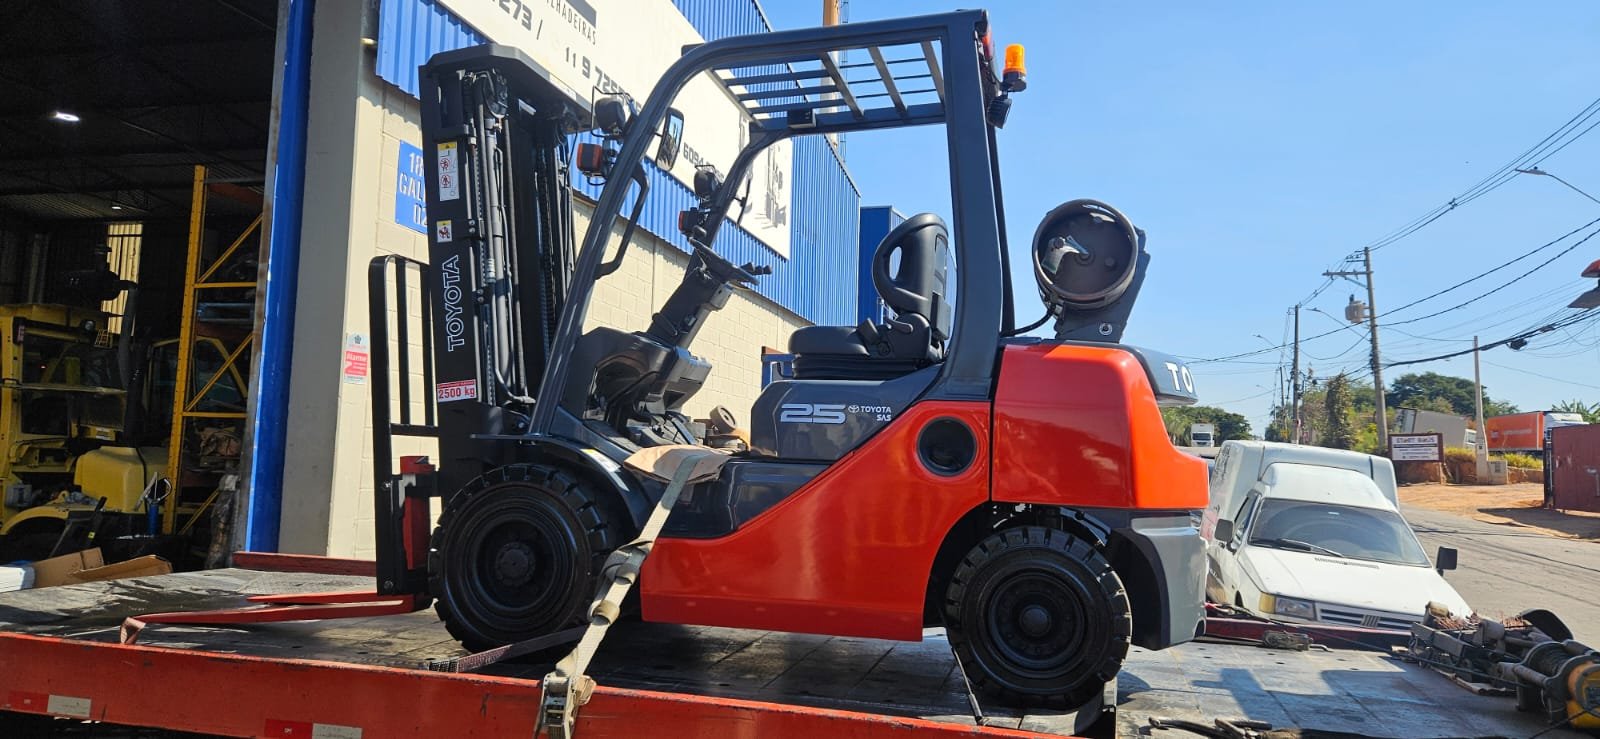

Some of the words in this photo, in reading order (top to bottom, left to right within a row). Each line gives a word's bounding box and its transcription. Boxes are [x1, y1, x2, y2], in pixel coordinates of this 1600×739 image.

[581, 56, 591, 79] 9
[442, 254, 465, 352] TOYOTA
[438, 387, 461, 399] 2500
[464, 386, 475, 398] kg
[780, 403, 846, 424] 25
[860, 405, 892, 413] TOYOTA
[876, 414, 892, 422] SAS
